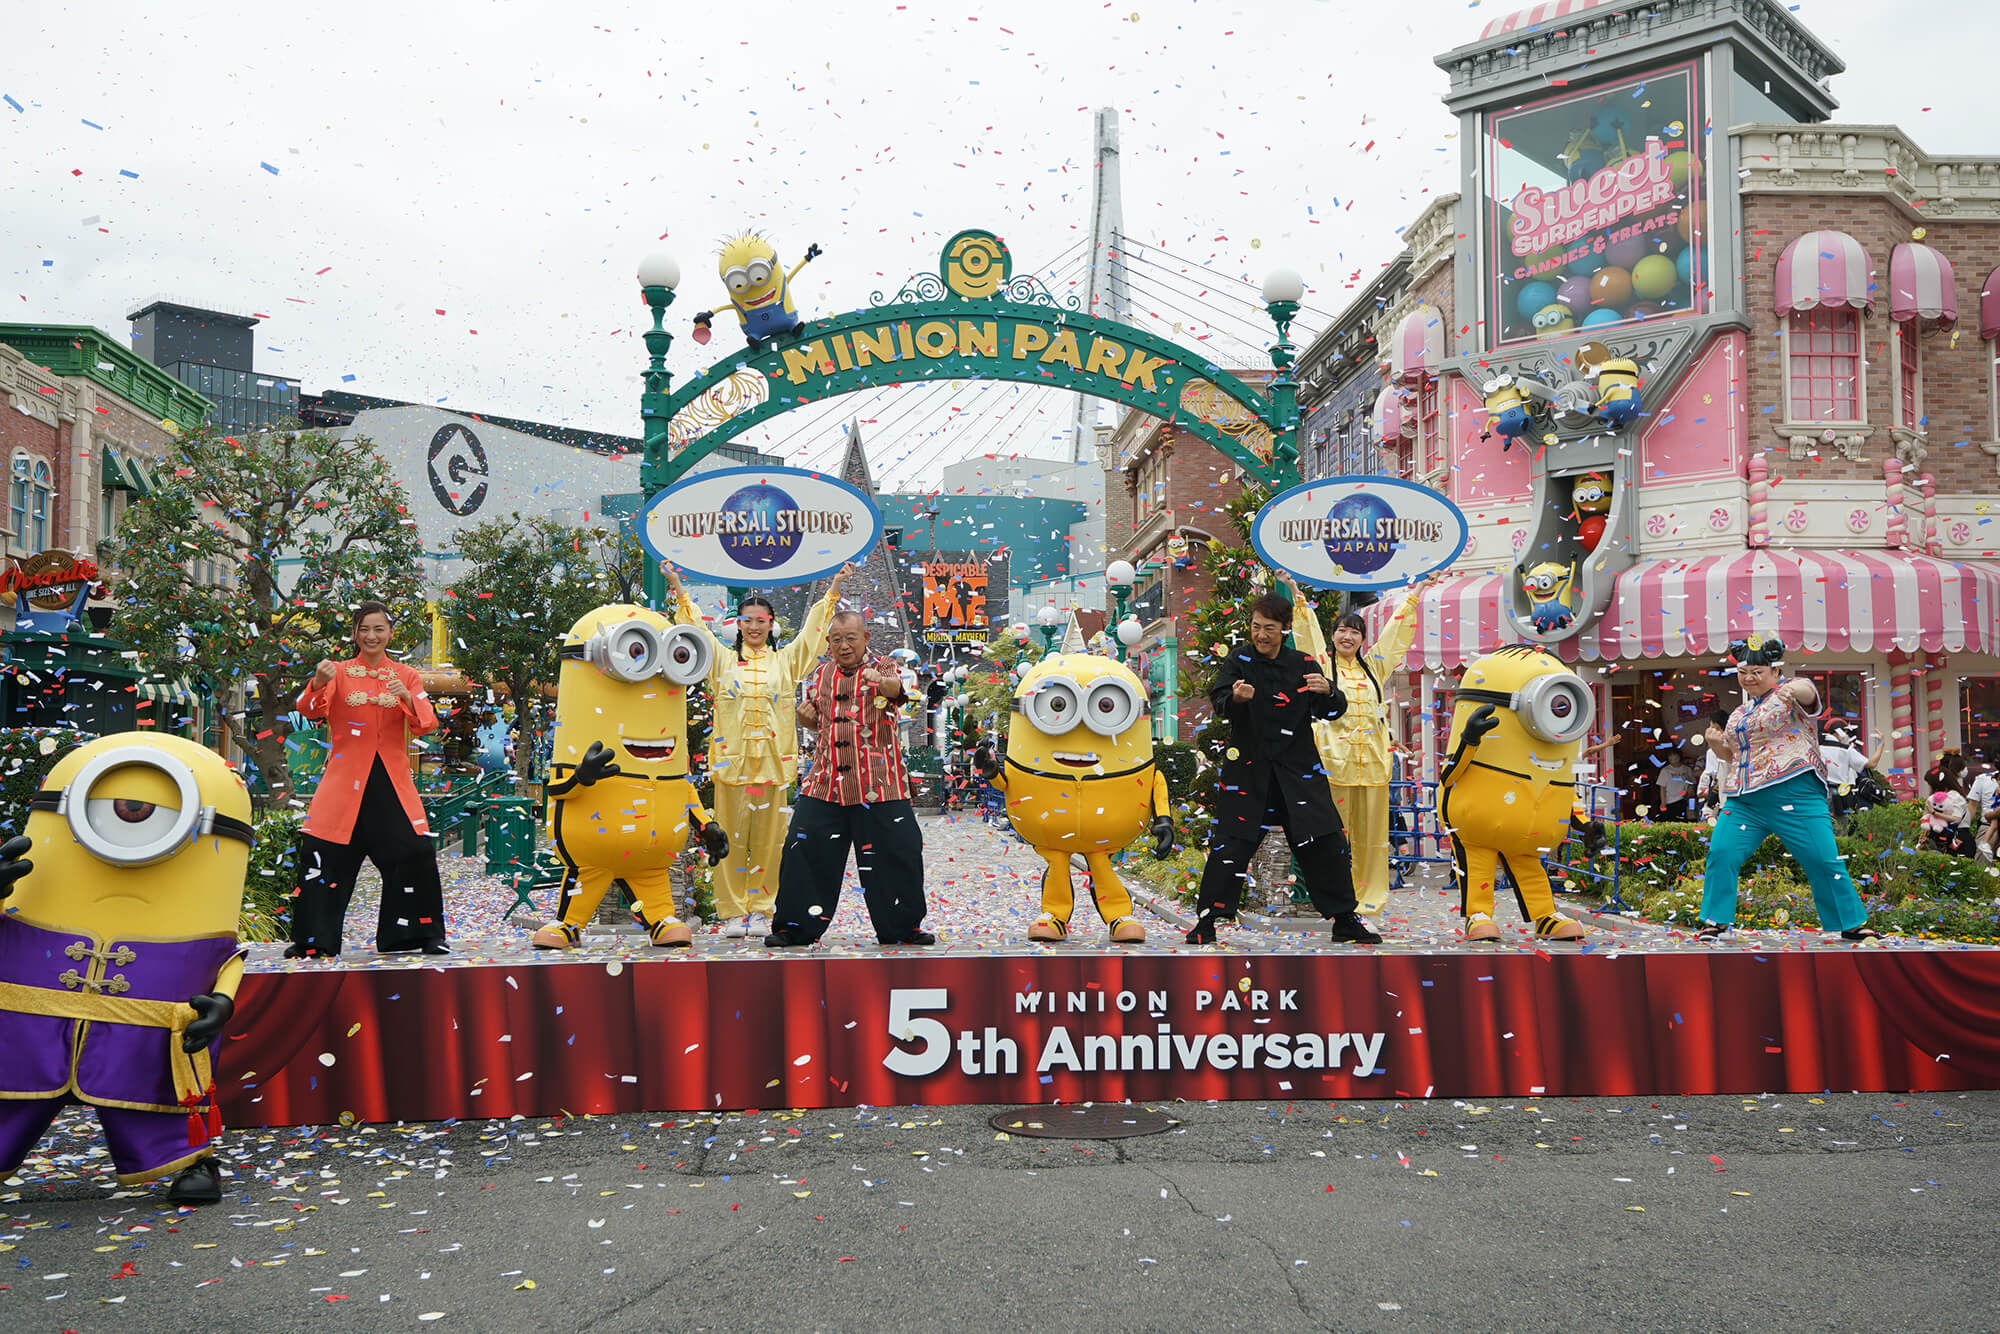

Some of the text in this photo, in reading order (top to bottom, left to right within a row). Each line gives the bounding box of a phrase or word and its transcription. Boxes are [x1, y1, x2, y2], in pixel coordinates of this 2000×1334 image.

[1513, 140, 1672, 235] Sweet
[1513, 182, 1674, 255] SURRENDER
[1514, 212, 1679, 279] CANDIES & TREATS
[782, 321, 1168, 393] MINION PARK
[668, 509, 853, 538] UNIVERSAL STUDIOS
[1280, 517, 1443, 542] UNIVERSAL STUDIOS
[731, 535, 792, 547] JAPAN
[1335, 541, 1389, 553] JAPAN
[923, 563, 988, 577] DESPICABLE
[923, 576, 988, 626] ME
[956, 631, 986, 642] MAYHEM
[1016, 989, 1299, 1013] MINION PARK
[882, 988, 1386, 1077] 5th Anniversary
